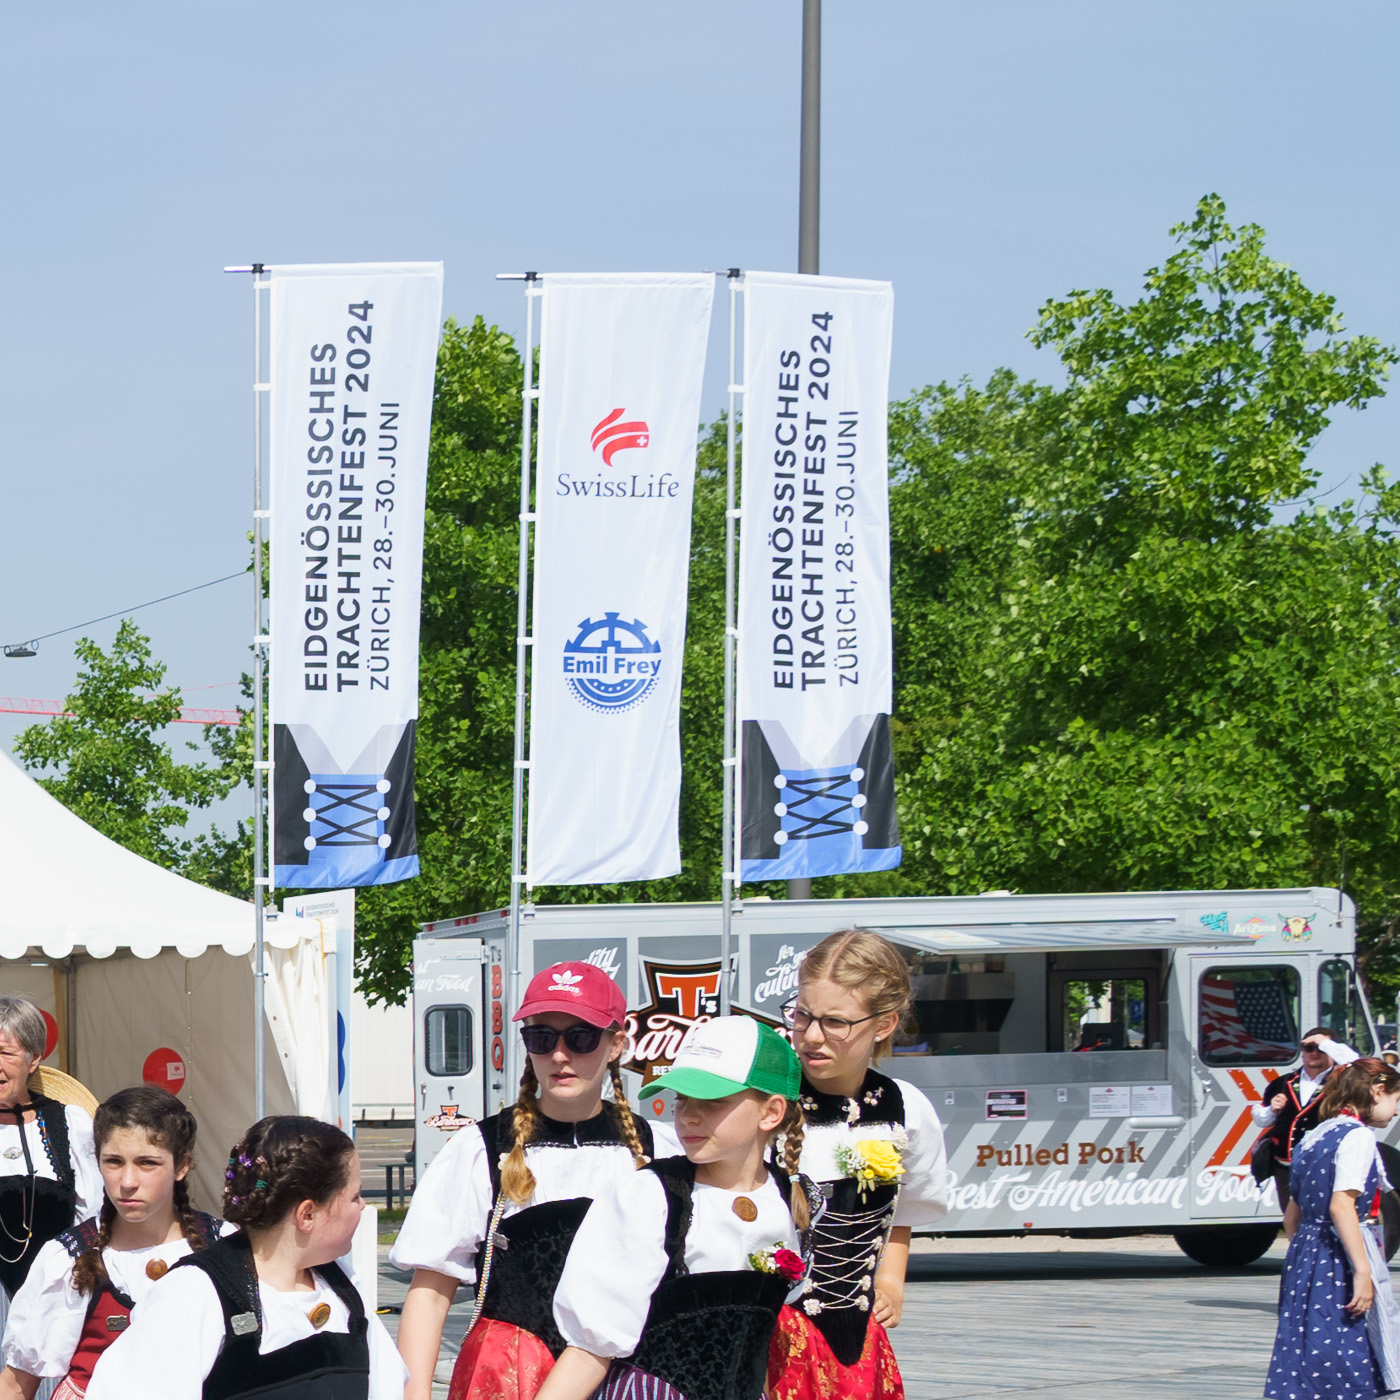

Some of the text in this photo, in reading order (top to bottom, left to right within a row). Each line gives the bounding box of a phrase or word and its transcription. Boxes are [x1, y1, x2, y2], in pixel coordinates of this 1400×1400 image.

[301, 343, 337, 691] EIDGENÖSSISCHES
[336, 300, 374, 692] TRACHTENFEST 2024
[556, 473, 680, 498] SwissLife
[768, 349, 801, 689] EIDGENÖSSISCHES
[801, 311, 834, 691] TRACHTENFEST 2024
[366, 579, 394, 691] ZÜRICH,
[563, 656, 662, 677] Emil Frey
[833, 579, 859, 687] ZÜRICH,
[491, 965, 504, 1073] BBQ
[547, 983, 580, 994] adidas
[976, 1141, 1147, 1168] Pulled Pork
[1008, 1170, 1190, 1212] American
